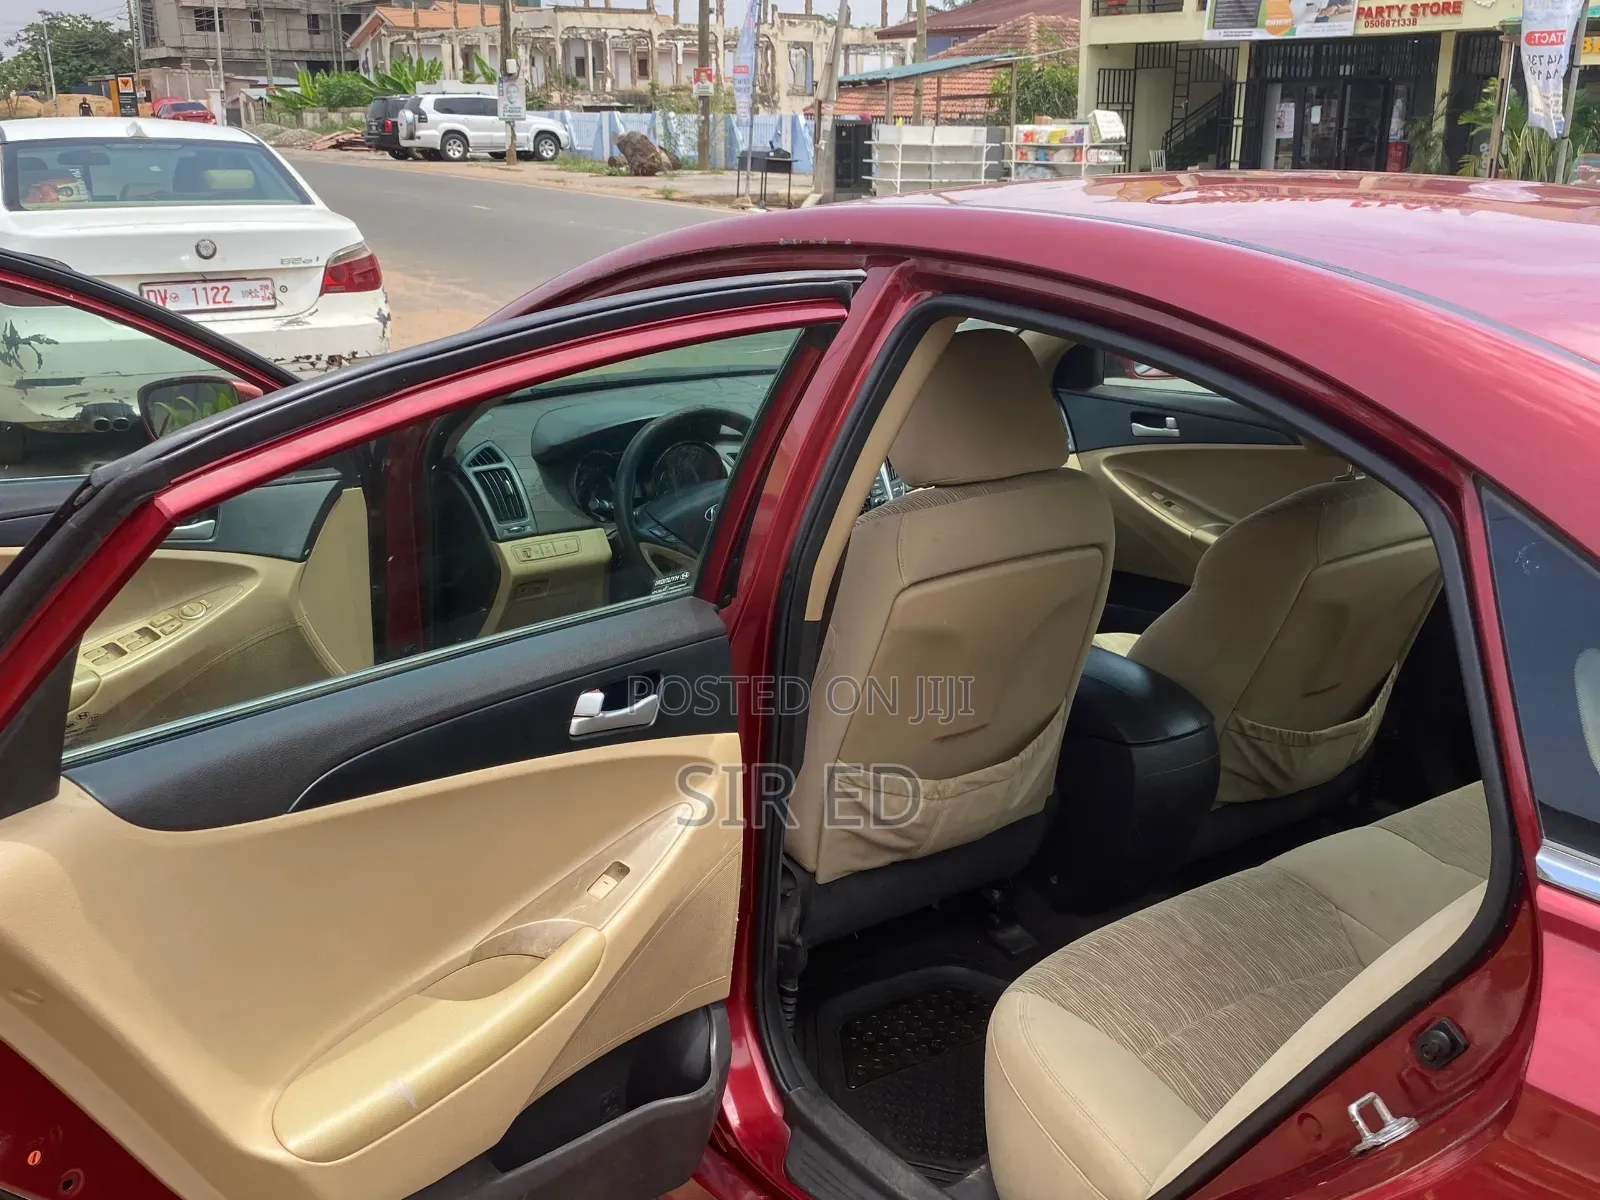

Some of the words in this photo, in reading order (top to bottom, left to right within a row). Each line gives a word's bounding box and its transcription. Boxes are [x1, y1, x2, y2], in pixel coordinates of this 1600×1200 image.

[1356, 4, 1406, 20] PARTY
[1409, 1, 1463, 17] STORE
[1364, 18, 1418, 29] 0506871338
[191, 286, 233, 306] 1122
